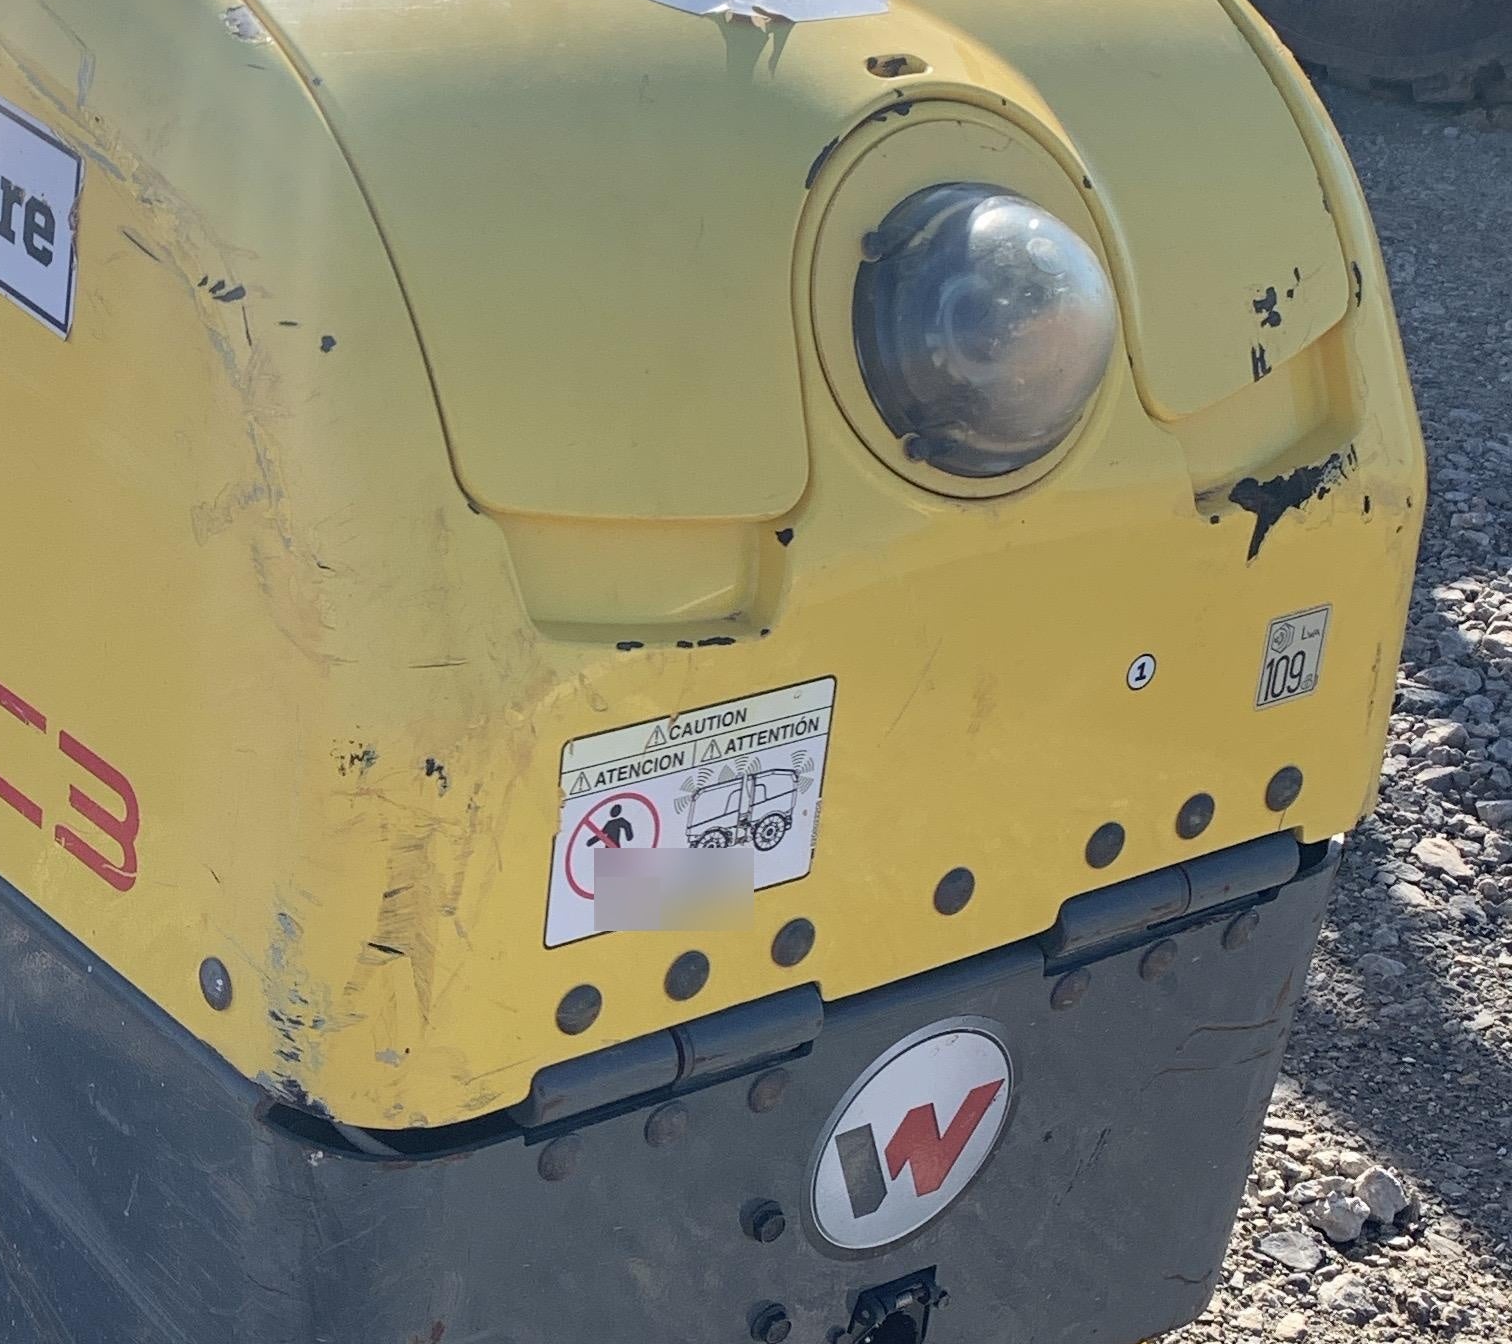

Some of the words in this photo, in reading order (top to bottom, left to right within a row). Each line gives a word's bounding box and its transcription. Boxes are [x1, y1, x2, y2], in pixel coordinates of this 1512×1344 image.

[1264, 650, 1306, 702] 109
[668, 707, 748, 742] CAUTION
[593, 750, 685, 789] ATENCION
